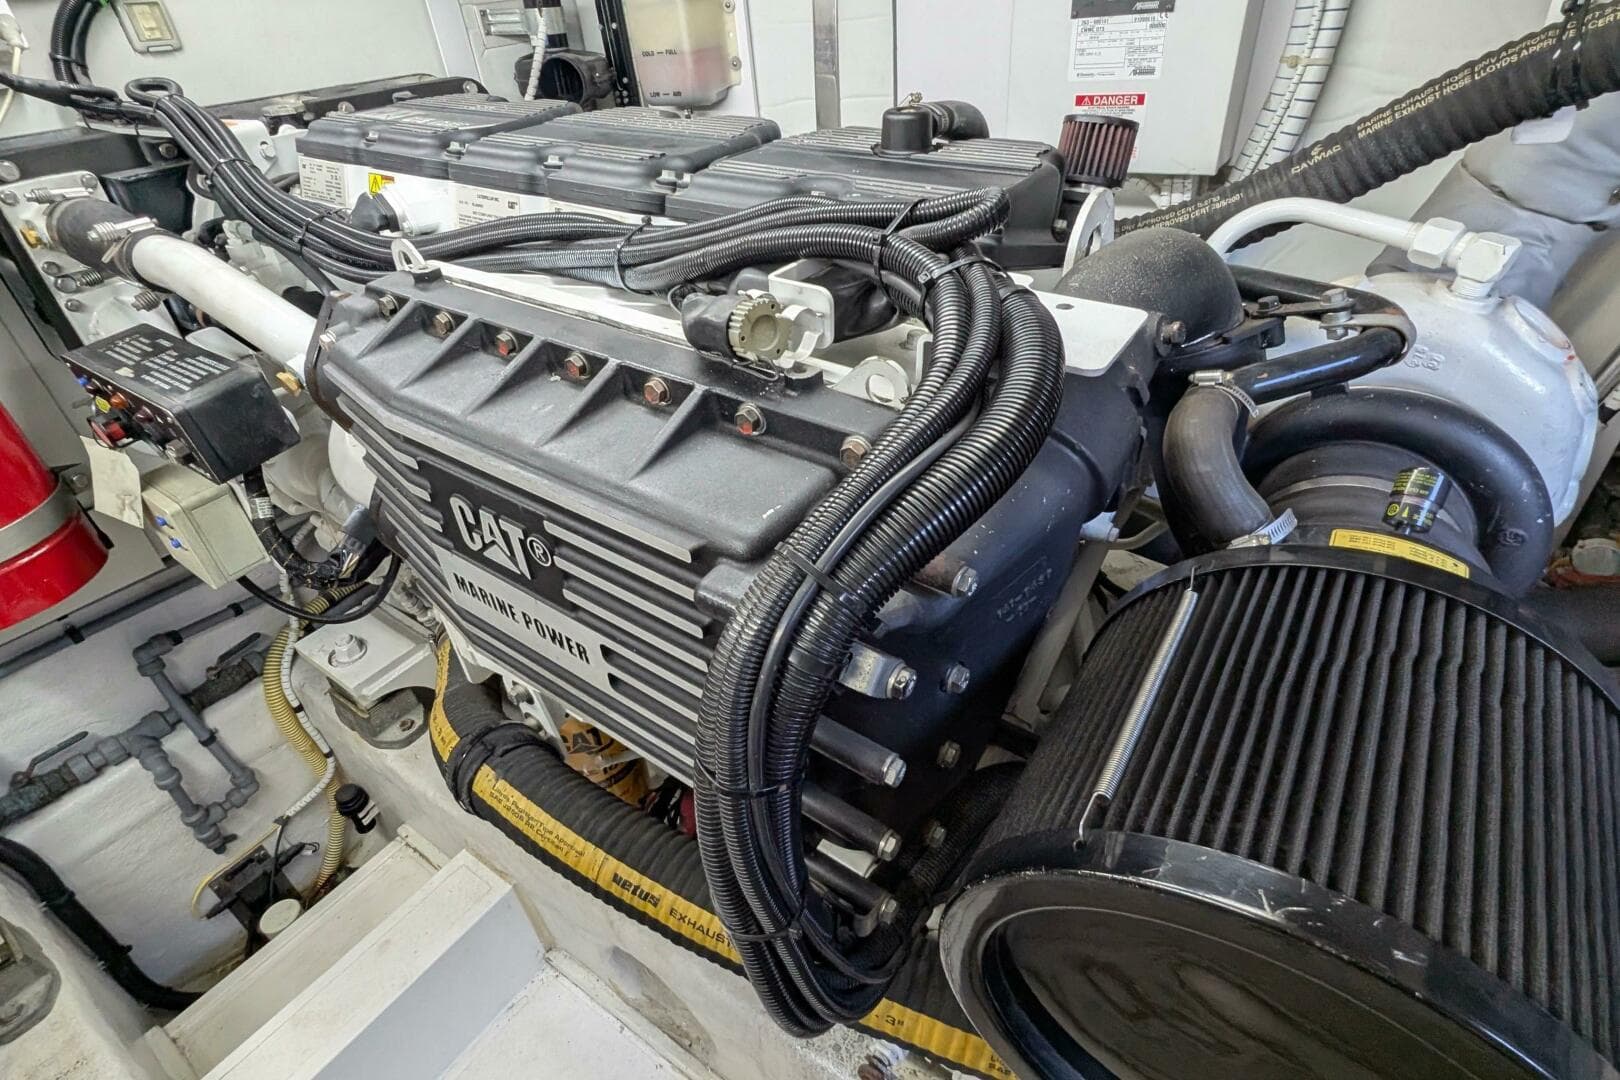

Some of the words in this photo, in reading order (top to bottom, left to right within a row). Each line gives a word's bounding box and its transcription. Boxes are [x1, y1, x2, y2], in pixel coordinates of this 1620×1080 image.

[1093, 95, 1138, 105] DANGER
[1356, 108, 1393, 130] MARINE
[1393, 83, 1440, 111] EXHAUST
[1442, 67, 1472, 88] HOSE
[1357, 116, 1394, 140] MARINE
[1395, 92, 1441, 119] EXHAUST
[1442, 75, 1473, 95] HOSE
[1474, 53, 1519, 80] LLOYDS
[1290, 144, 1342, 175] CAVMAC
[1190, 206, 1211, 220] CERT
[453, 573, 519, 624] MARINE
[521, 611, 591, 665] POWER
